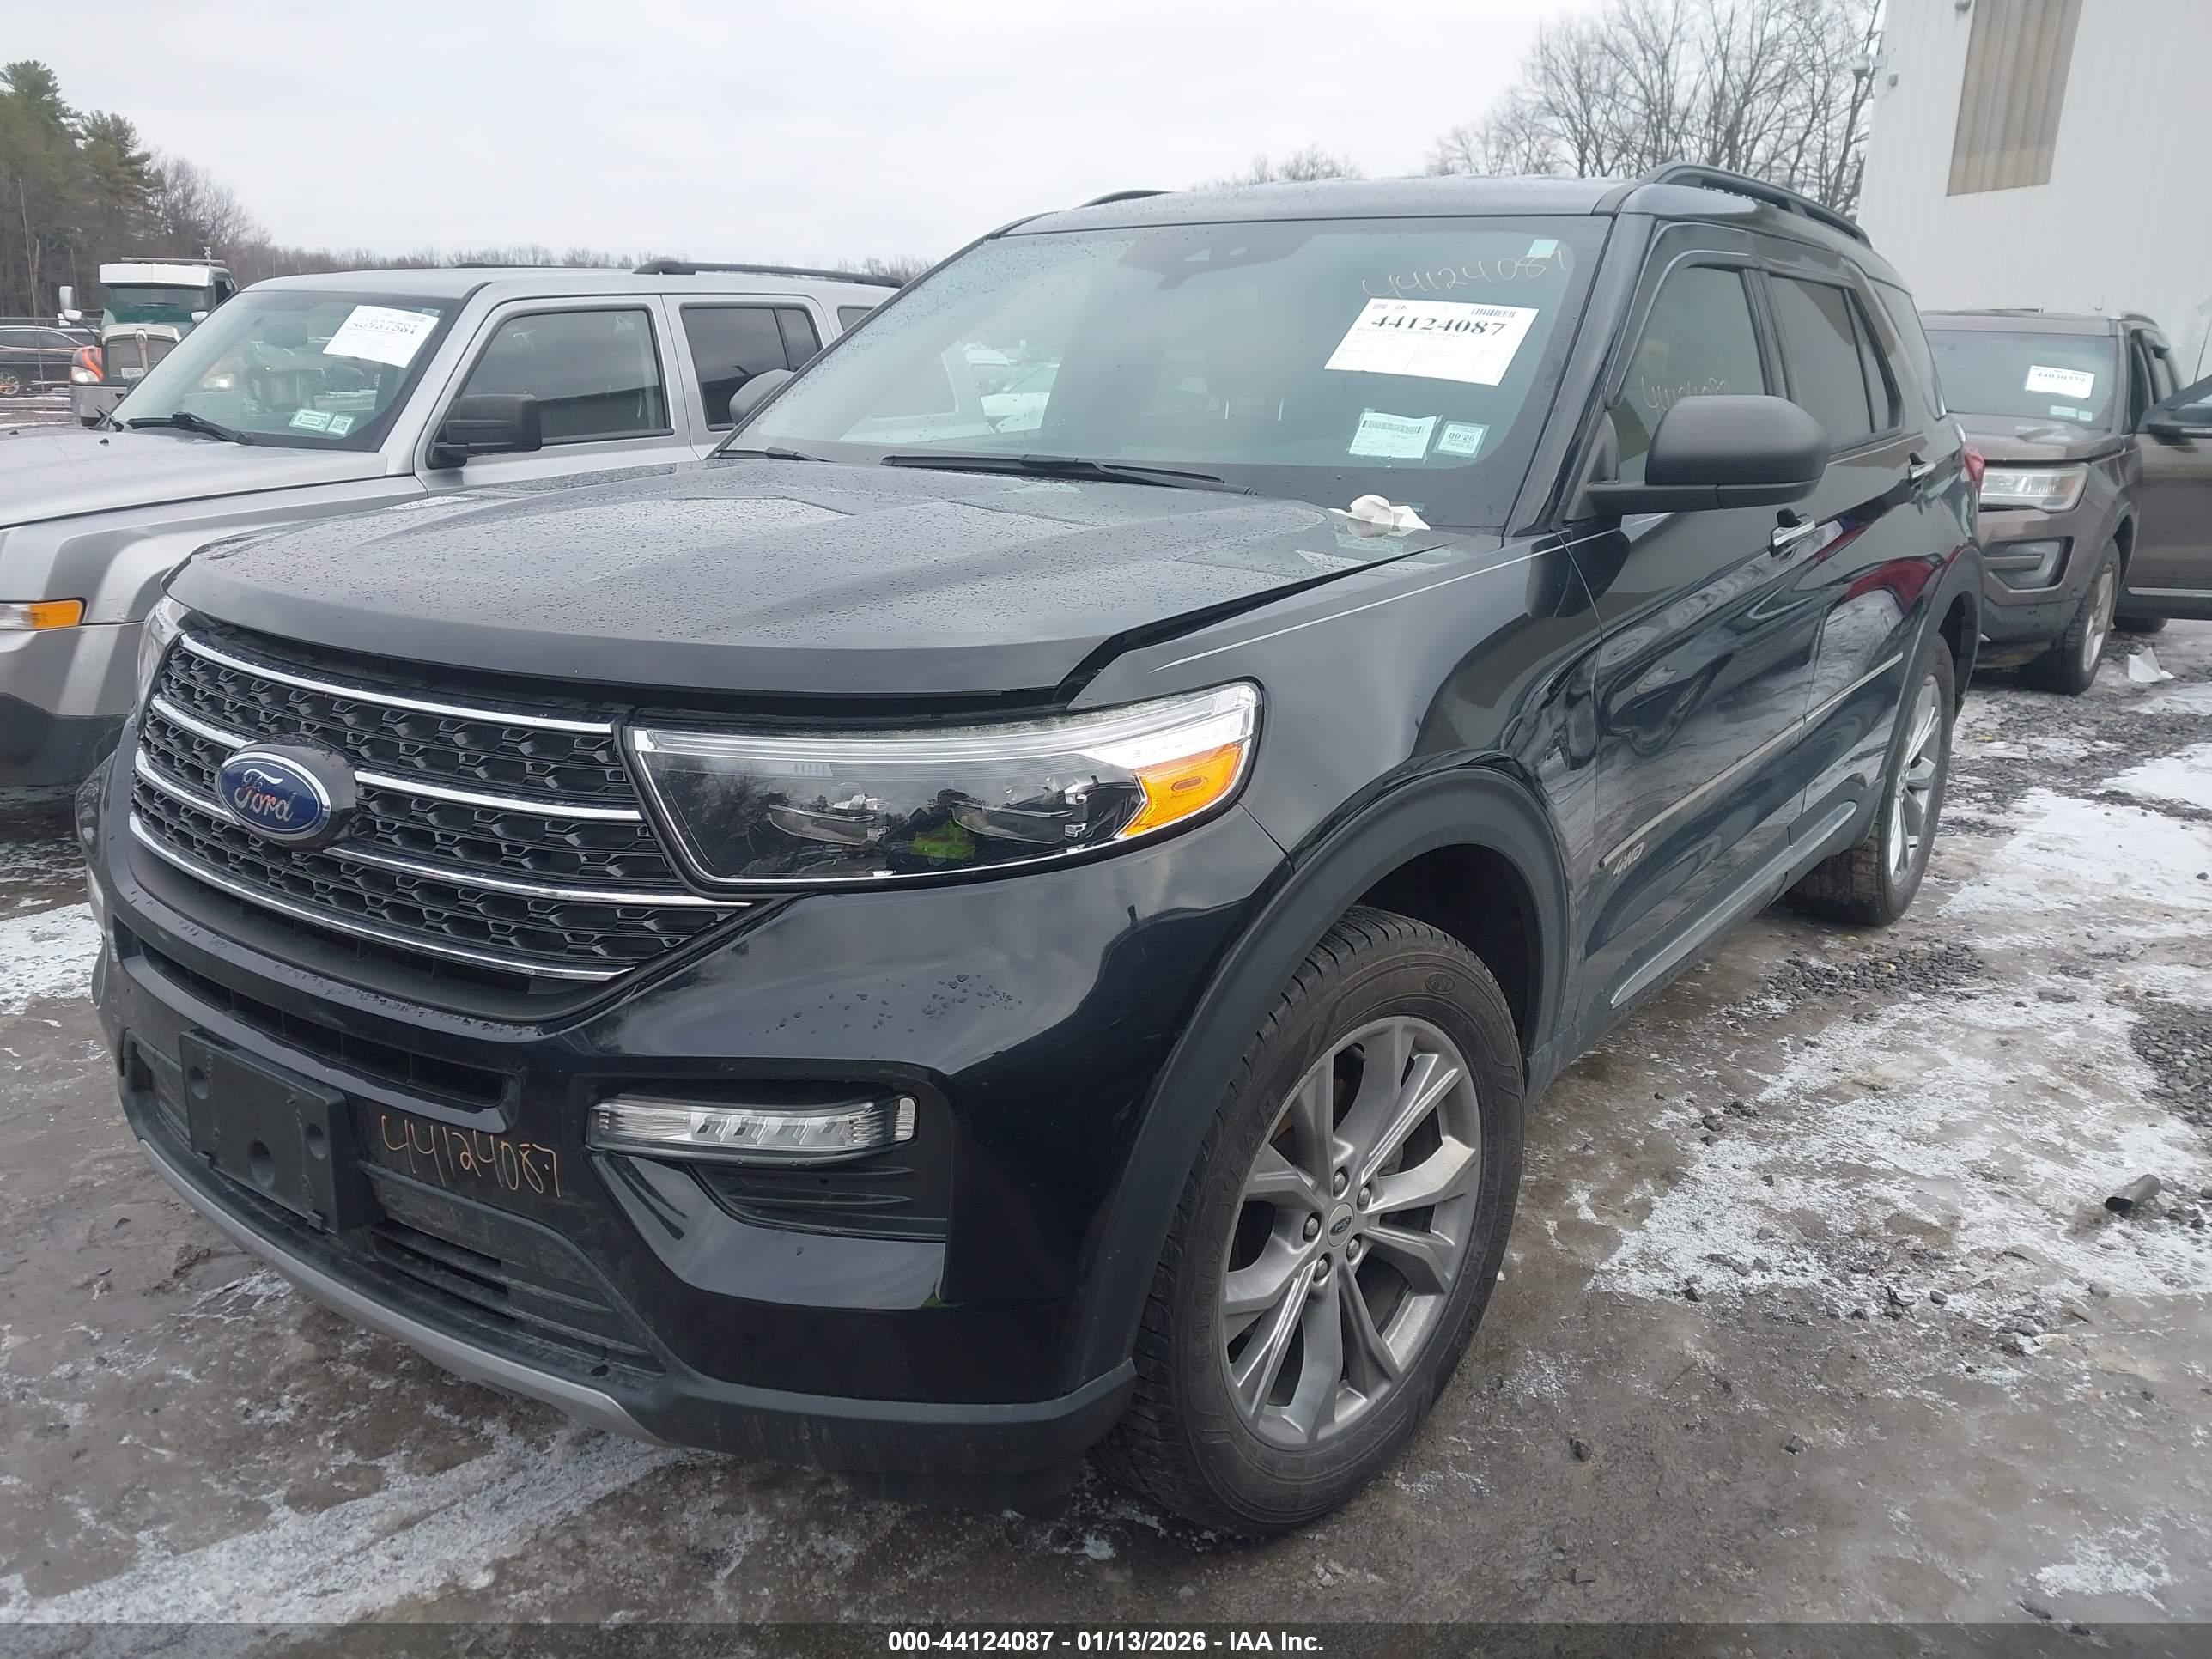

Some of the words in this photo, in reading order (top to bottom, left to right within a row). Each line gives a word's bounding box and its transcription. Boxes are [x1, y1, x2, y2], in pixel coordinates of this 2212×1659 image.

[1371, 314, 1507, 337] 44124087
[234, 768, 298, 823] Ford
[380, 1114, 561, 1199] 44124087
